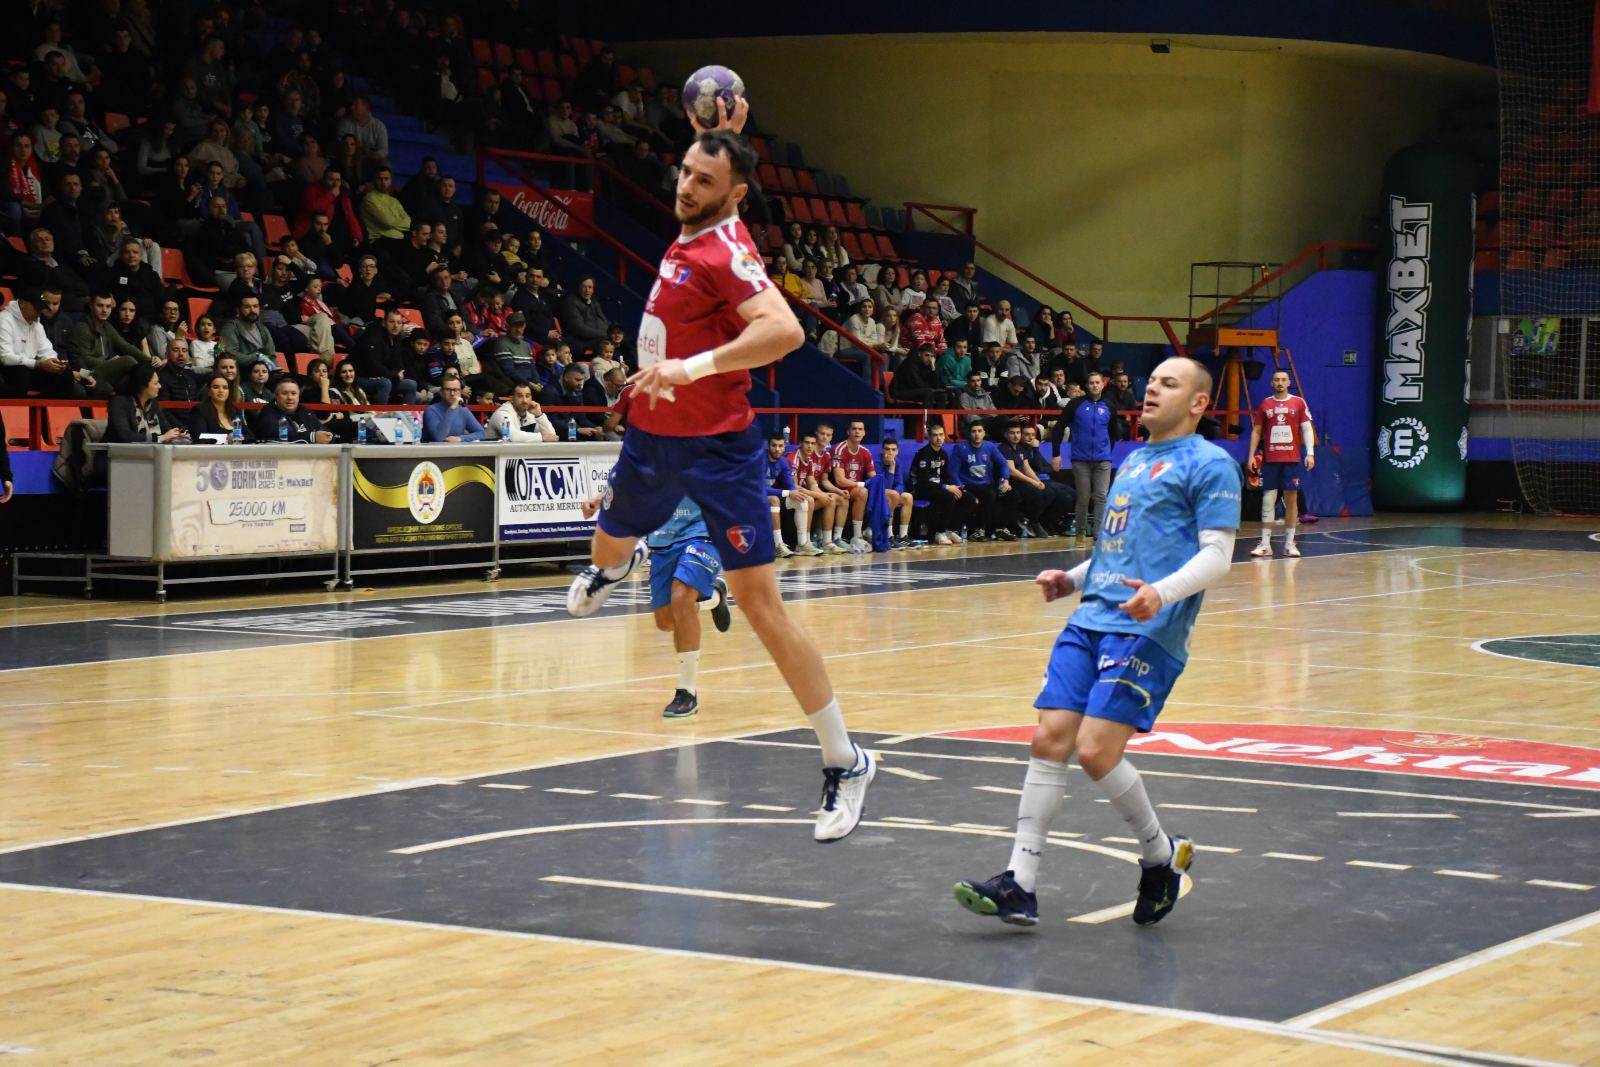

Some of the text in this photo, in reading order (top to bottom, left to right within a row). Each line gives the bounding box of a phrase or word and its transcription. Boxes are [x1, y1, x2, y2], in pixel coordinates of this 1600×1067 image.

[1383, 194, 1433, 405] MAXBET
[231, 470, 257, 490] BORIK
[591, 469, 610, 481] Ovla
[258, 481, 276, 489] 2025
[228, 500, 286, 517] 25.000 KM
[509, 502, 555, 513] AUTOCENTAR
